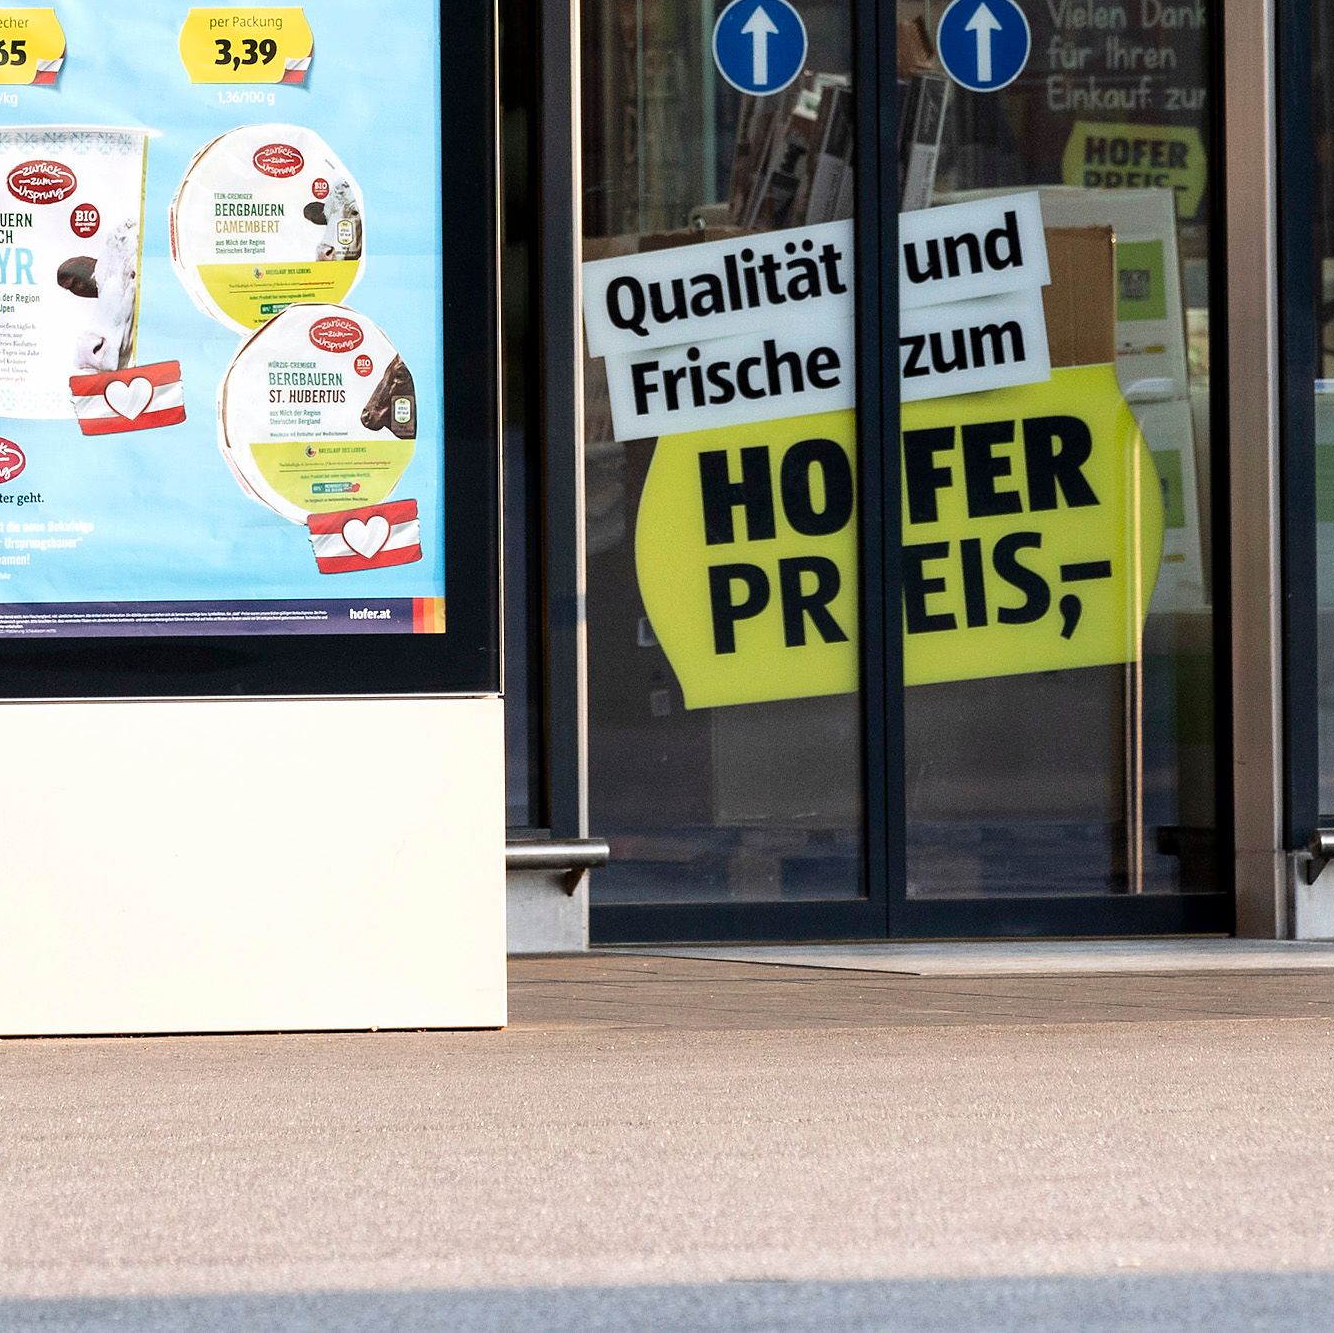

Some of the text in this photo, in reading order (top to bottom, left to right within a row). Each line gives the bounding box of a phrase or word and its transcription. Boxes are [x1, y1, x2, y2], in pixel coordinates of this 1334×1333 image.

[209, 16, 283, 30] per Packung
[214, 39, 277, 71] 3,39
[1047, 33, 1177, 71] für Ihren
[1047, 75, 1153, 111] Einkauf
[264, 145, 294, 157] zurück
[1084, 136, 1189, 169] HOFER
[22, 162, 62, 177] zurück
[262, 164, 296, 176] Ursprung
[30, 177, 52, 185] zum
[314, 182, 327, 190] BIO
[18, 185, 64, 203] Ursprung
[75, 210, 96, 222] BIO
[214, 203, 284, 217] BERGBAUERN
[215, 220, 280, 234] CAMEMBERT
[606, 211, 1023, 337] Qualität und
[2, 293, 14, 302] der
[15, 293, 40, 304] Region
[321, 320, 353, 331] zurück
[318, 338, 356, 351] Ursprung
[357, 359, 371, 367] BIO
[632, 318, 1026, 416] Frische zum
[268, 372, 343, 386] BERGBAUERN
[269, 389, 346, 403] ST. HUBERTUS
[303, 409, 321, 418] Region
[698, 415, 1101, 547] HOFER
[17, 493, 44, 506] geht.
[349, 608, 391, 620] hofer.at
